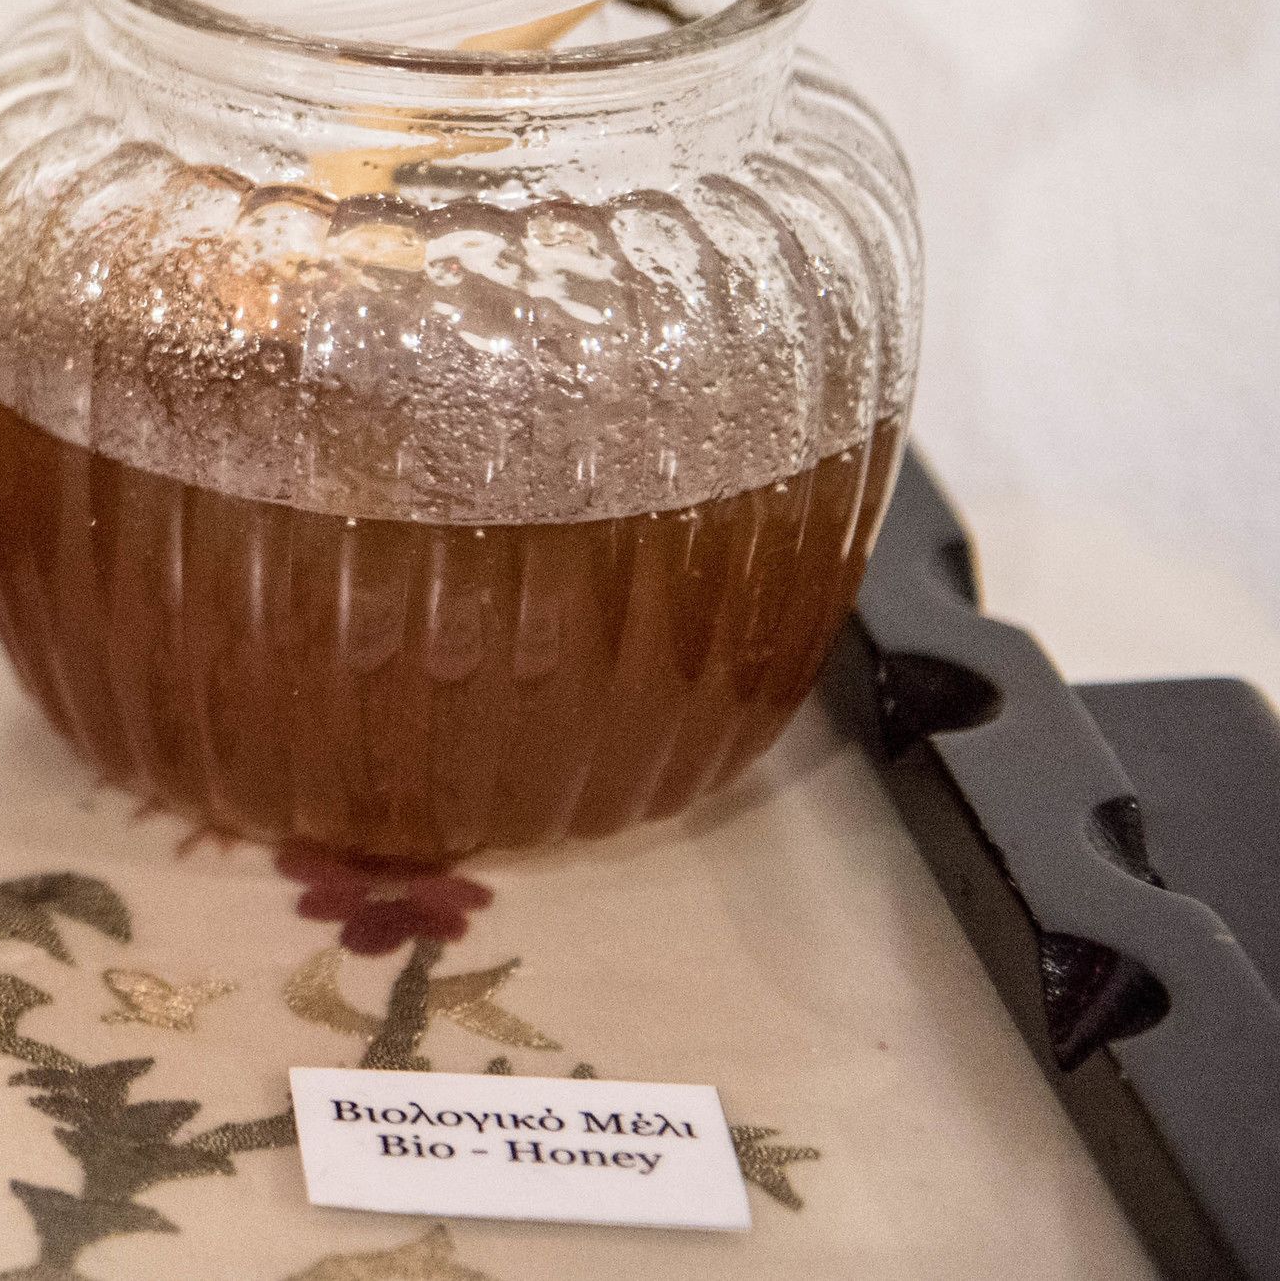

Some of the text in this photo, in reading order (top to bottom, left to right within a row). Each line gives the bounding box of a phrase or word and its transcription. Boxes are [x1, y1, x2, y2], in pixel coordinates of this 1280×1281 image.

[330, 1098, 699, 1139] Βιολογικό Μέλι
[377, 1134, 455, 1159] Bio
[505, 1139, 663, 1175] Honey
